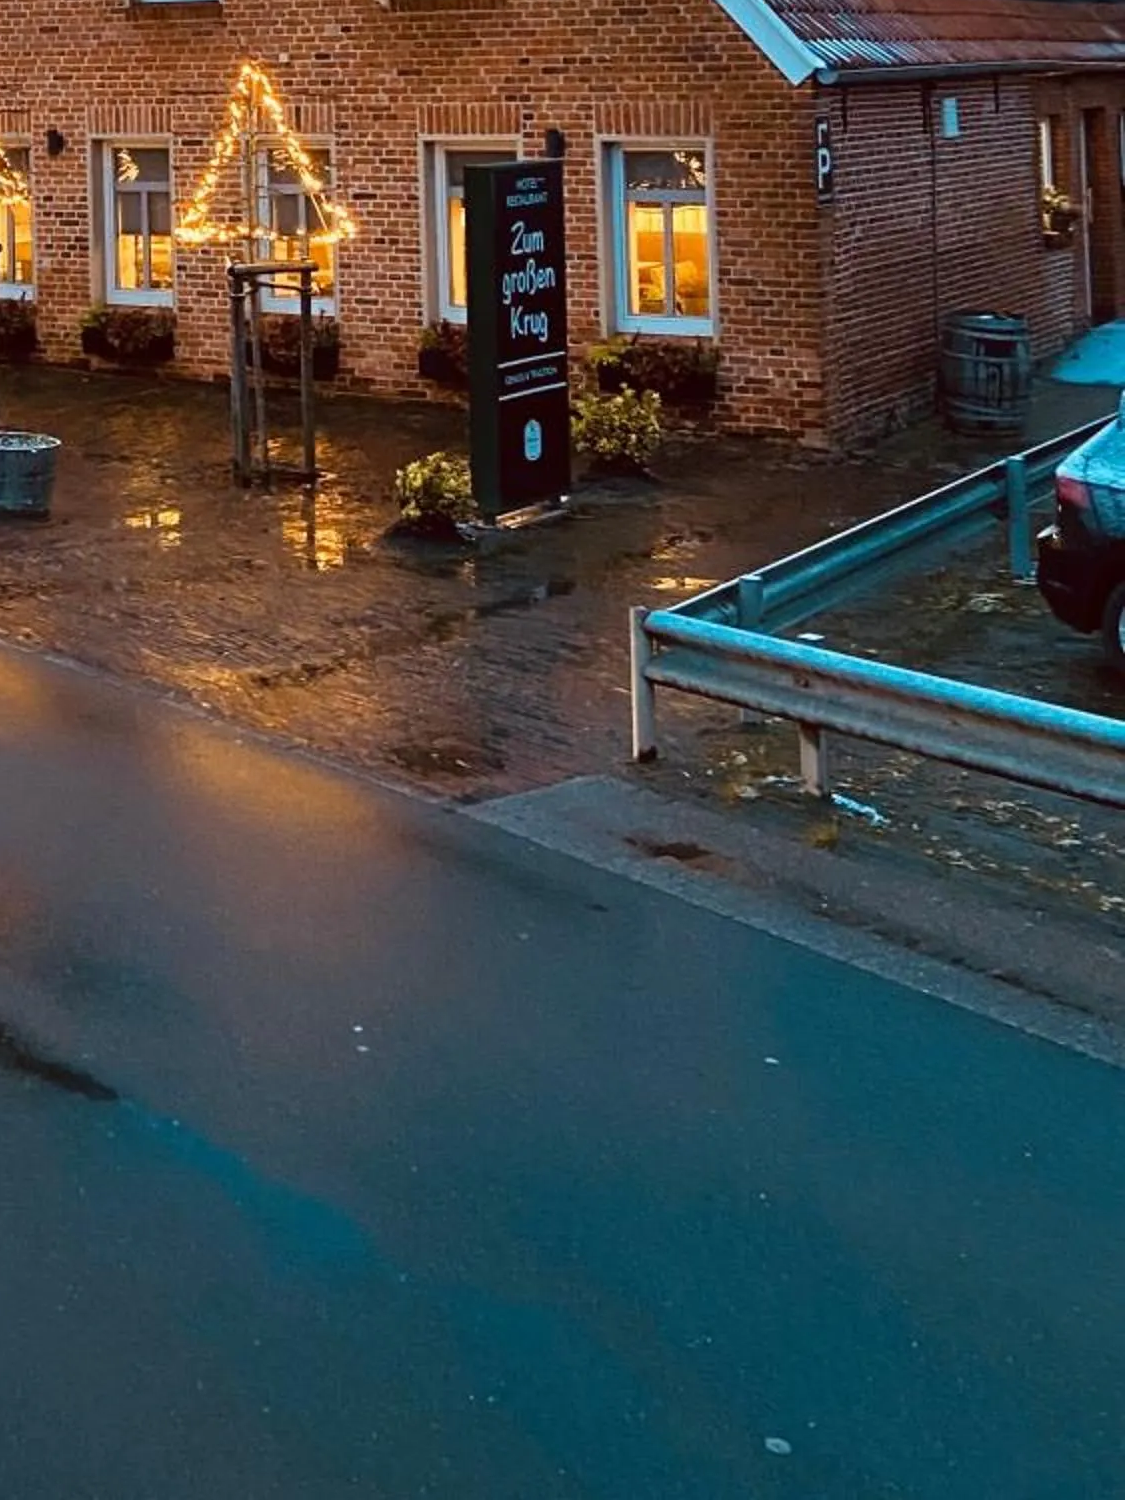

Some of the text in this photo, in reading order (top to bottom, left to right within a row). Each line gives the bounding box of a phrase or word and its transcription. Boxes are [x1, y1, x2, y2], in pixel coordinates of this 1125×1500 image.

[511, 220, 544, 255] Zum
[502, 258, 555, 305] großen
[510, 305, 548, 342] Krug
